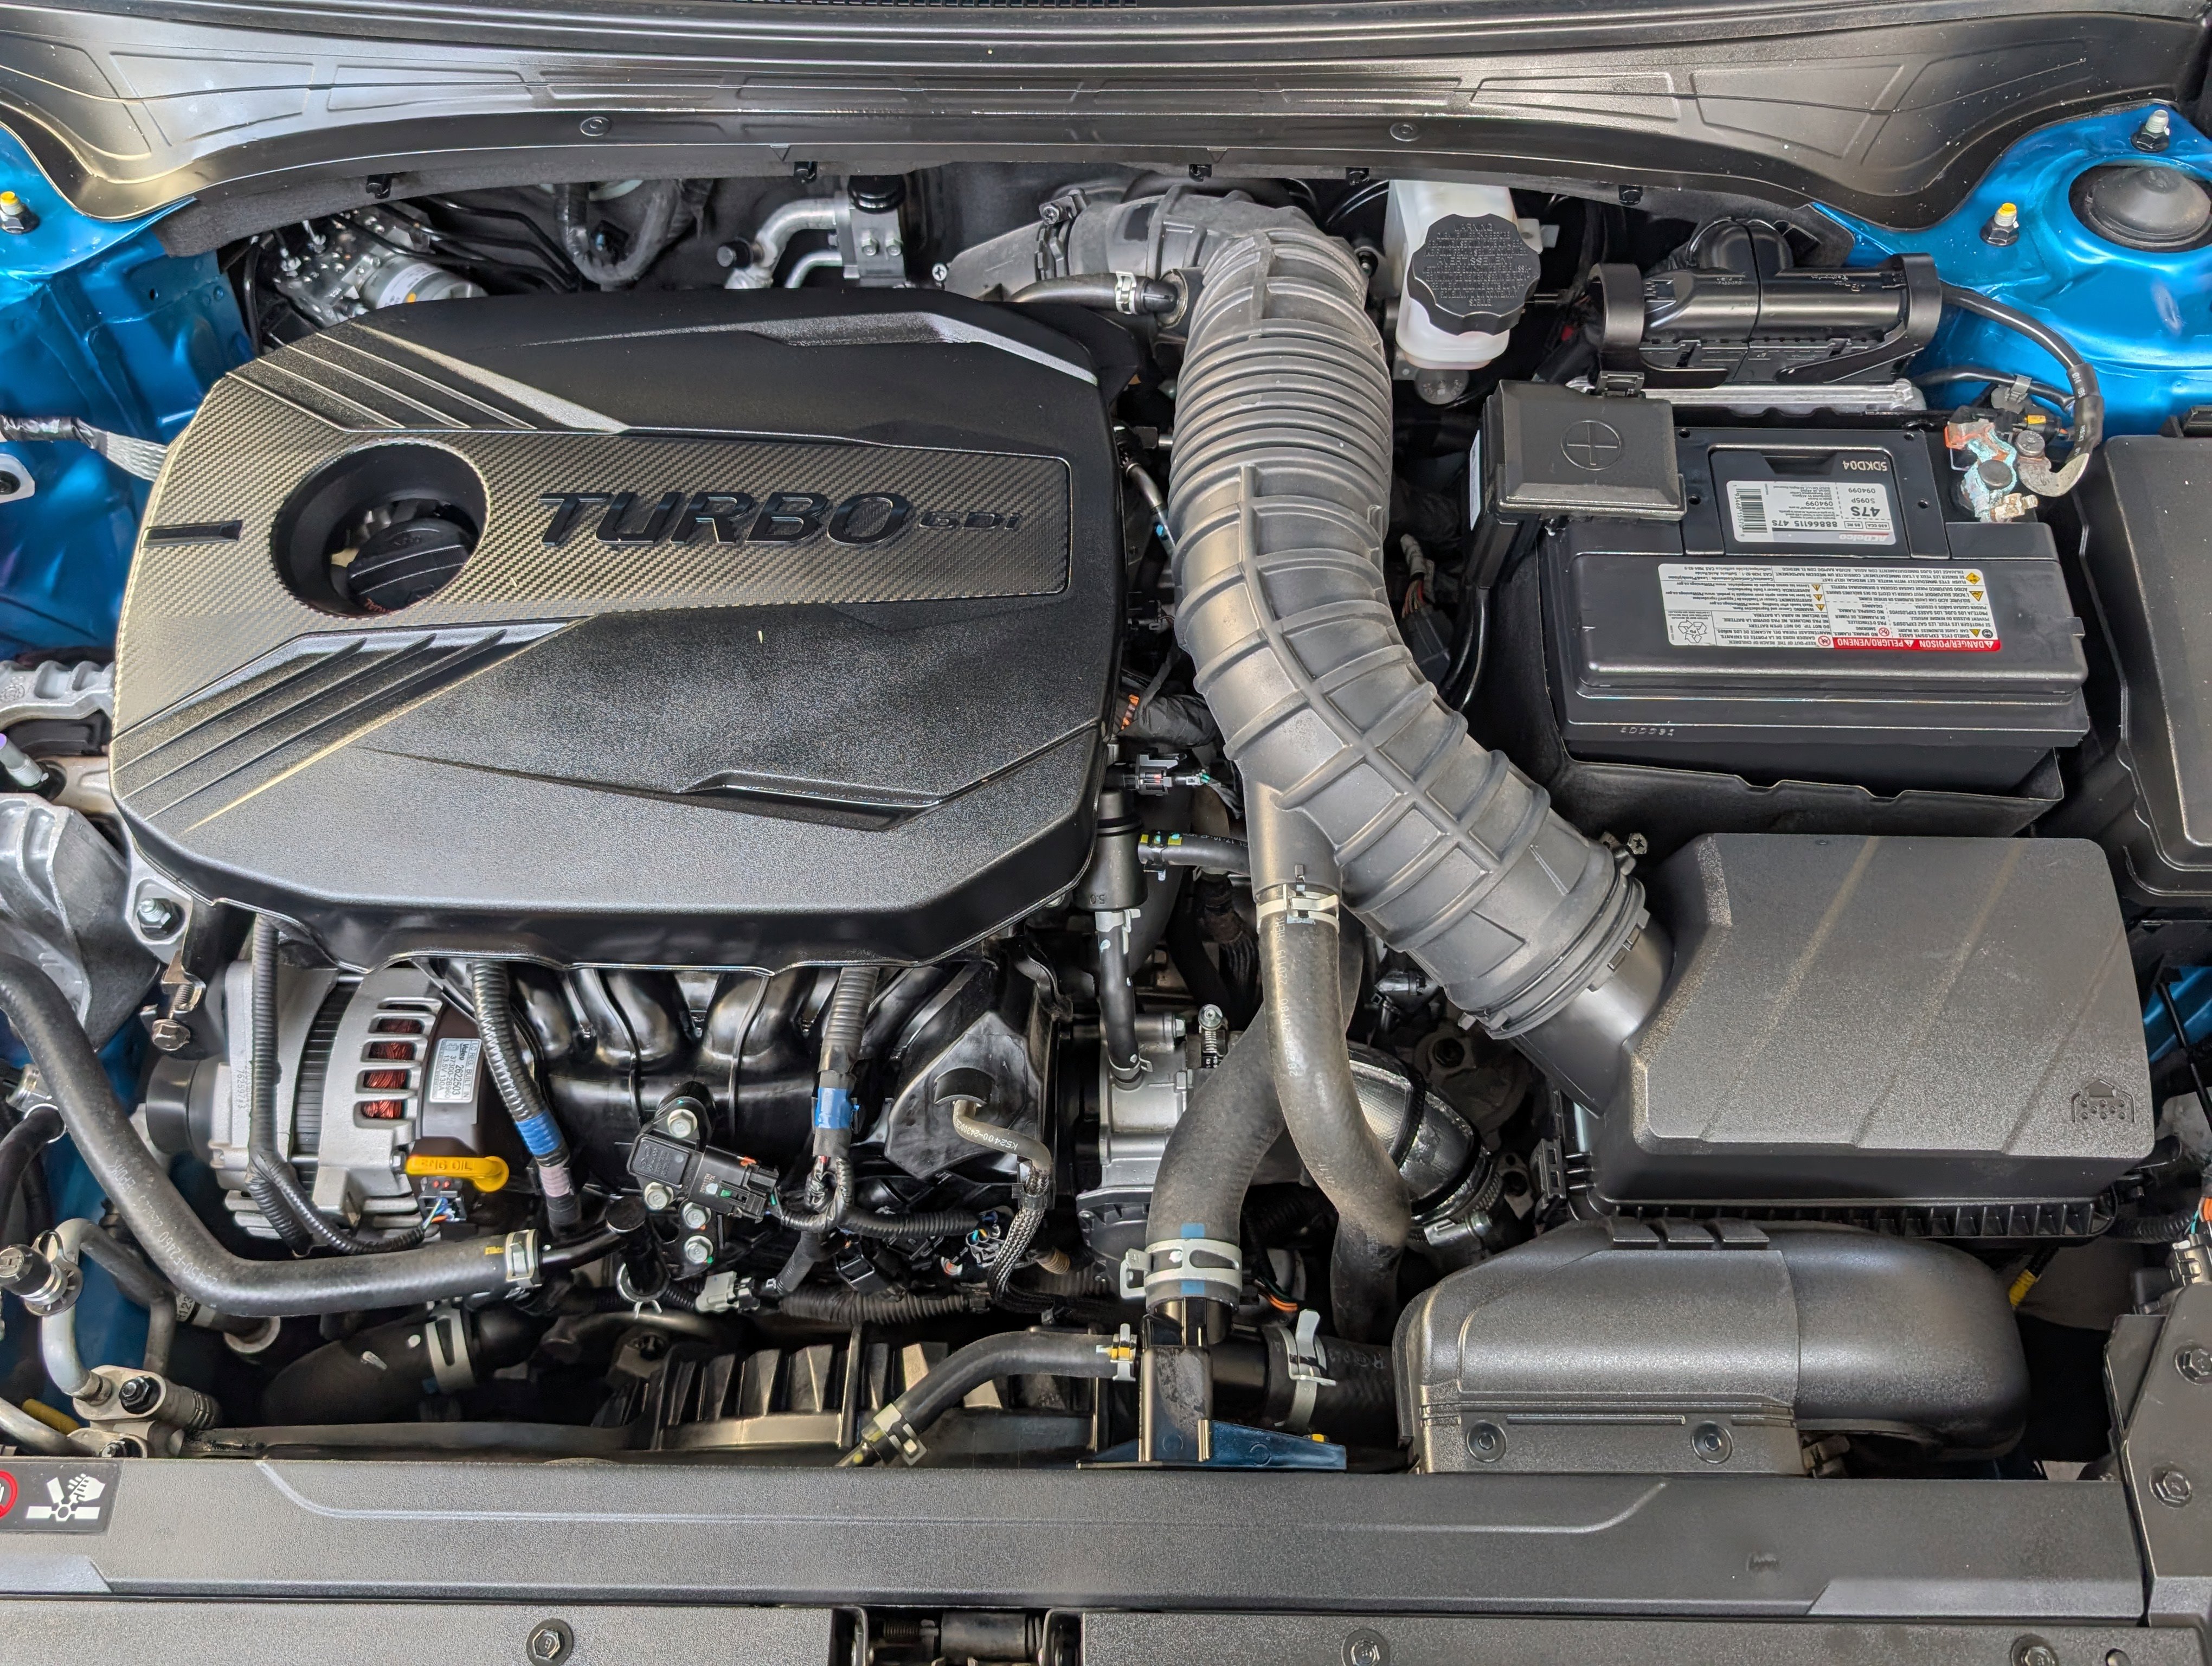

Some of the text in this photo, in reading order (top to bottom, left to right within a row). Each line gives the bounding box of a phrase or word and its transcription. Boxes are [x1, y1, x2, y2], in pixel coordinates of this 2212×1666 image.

[1842, 460, 1887, 471] 5DKD04
[538, 490, 910, 546] TURBO
[1850, 507, 1881, 516] 47S
[1737, 512, 1745, 528] 15570
[1794, 520, 1838, 528] 88866115
[1839, 534, 1888, 542] ACDelco
[1837, 638, 1984, 649] DANGER/POISON PELIGRO/VENENO
[441, 1054, 449, 1073] 13.5V
[467, 1053, 476, 1067] REG.
[452, 1043, 469, 1095] Valeo 2622503
[445, 1055, 456, 1098] 37300-2B960
[452, 1159, 473, 1171] OIL
